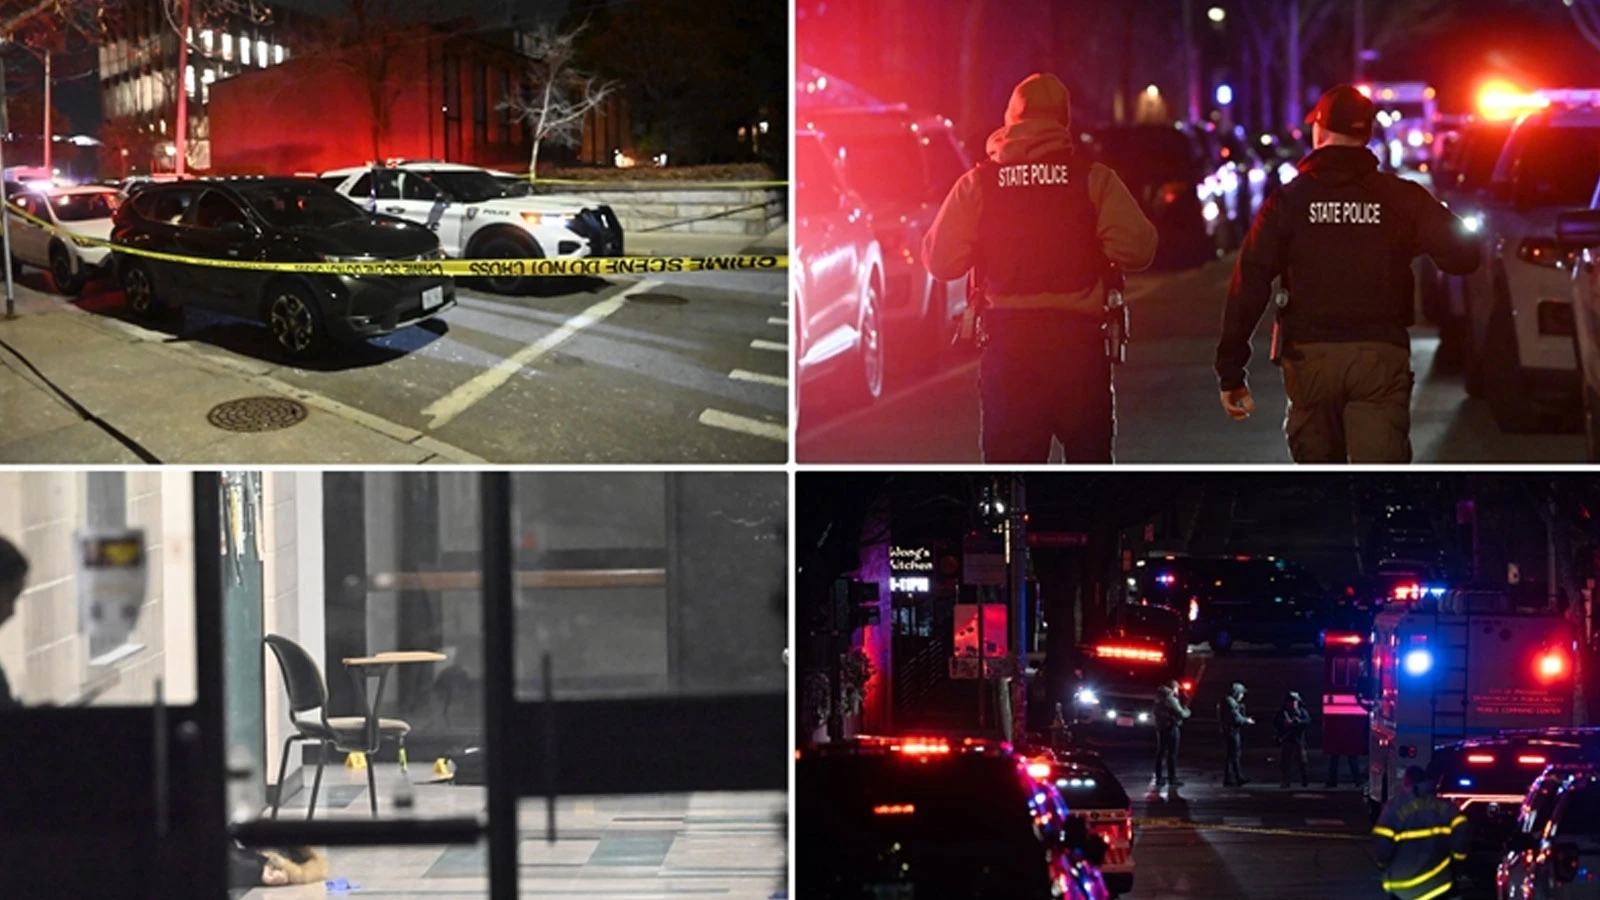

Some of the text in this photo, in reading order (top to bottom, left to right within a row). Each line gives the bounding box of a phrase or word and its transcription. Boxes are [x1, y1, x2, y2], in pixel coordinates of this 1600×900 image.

[998, 163, 1069, 187] STATE POLICE
[1308, 202, 1381, 223] STATE POLICE
[469, 256, 778, 275] CRIME SCENE DO NOT CROSS
